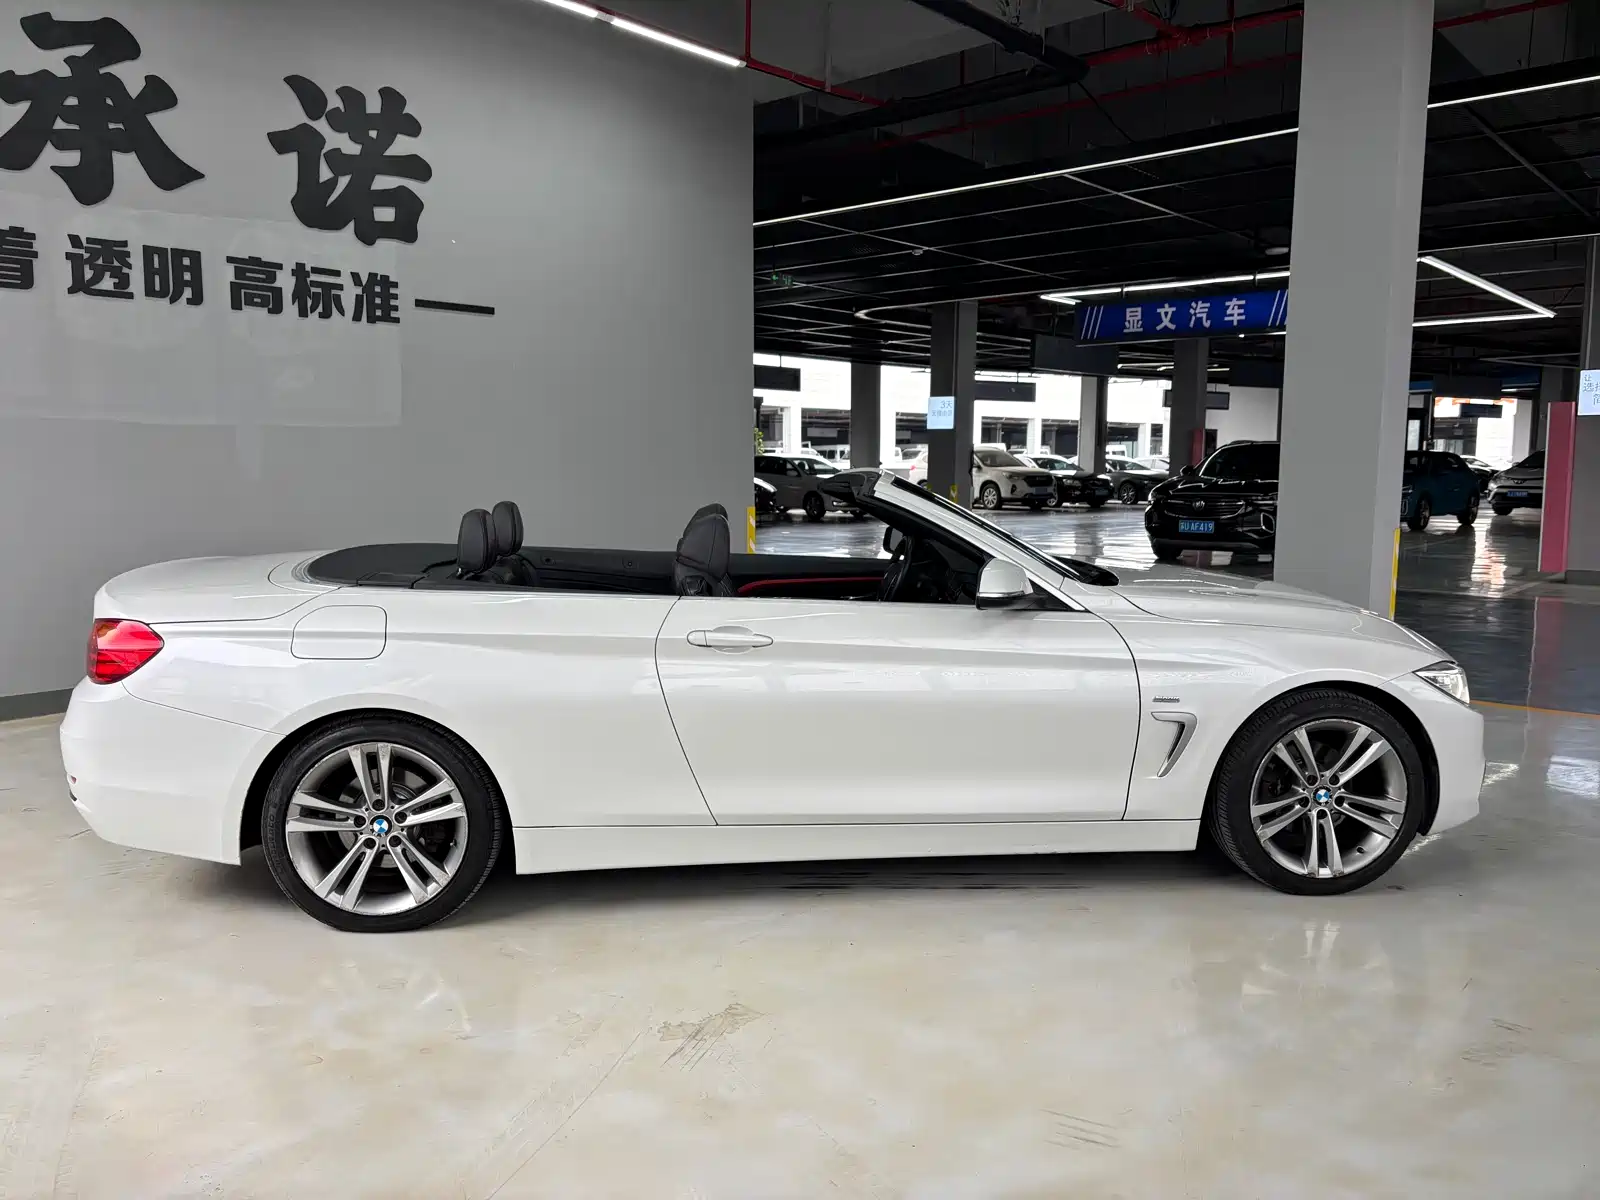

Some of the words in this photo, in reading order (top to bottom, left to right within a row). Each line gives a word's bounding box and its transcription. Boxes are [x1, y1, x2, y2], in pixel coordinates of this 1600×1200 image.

[0, 11, 432, 247] 承诺
[65, 233, 204, 306] 透明
[226, 255, 401, 325] 高标准
[1123, 297, 1246, 333] 显文汽车
